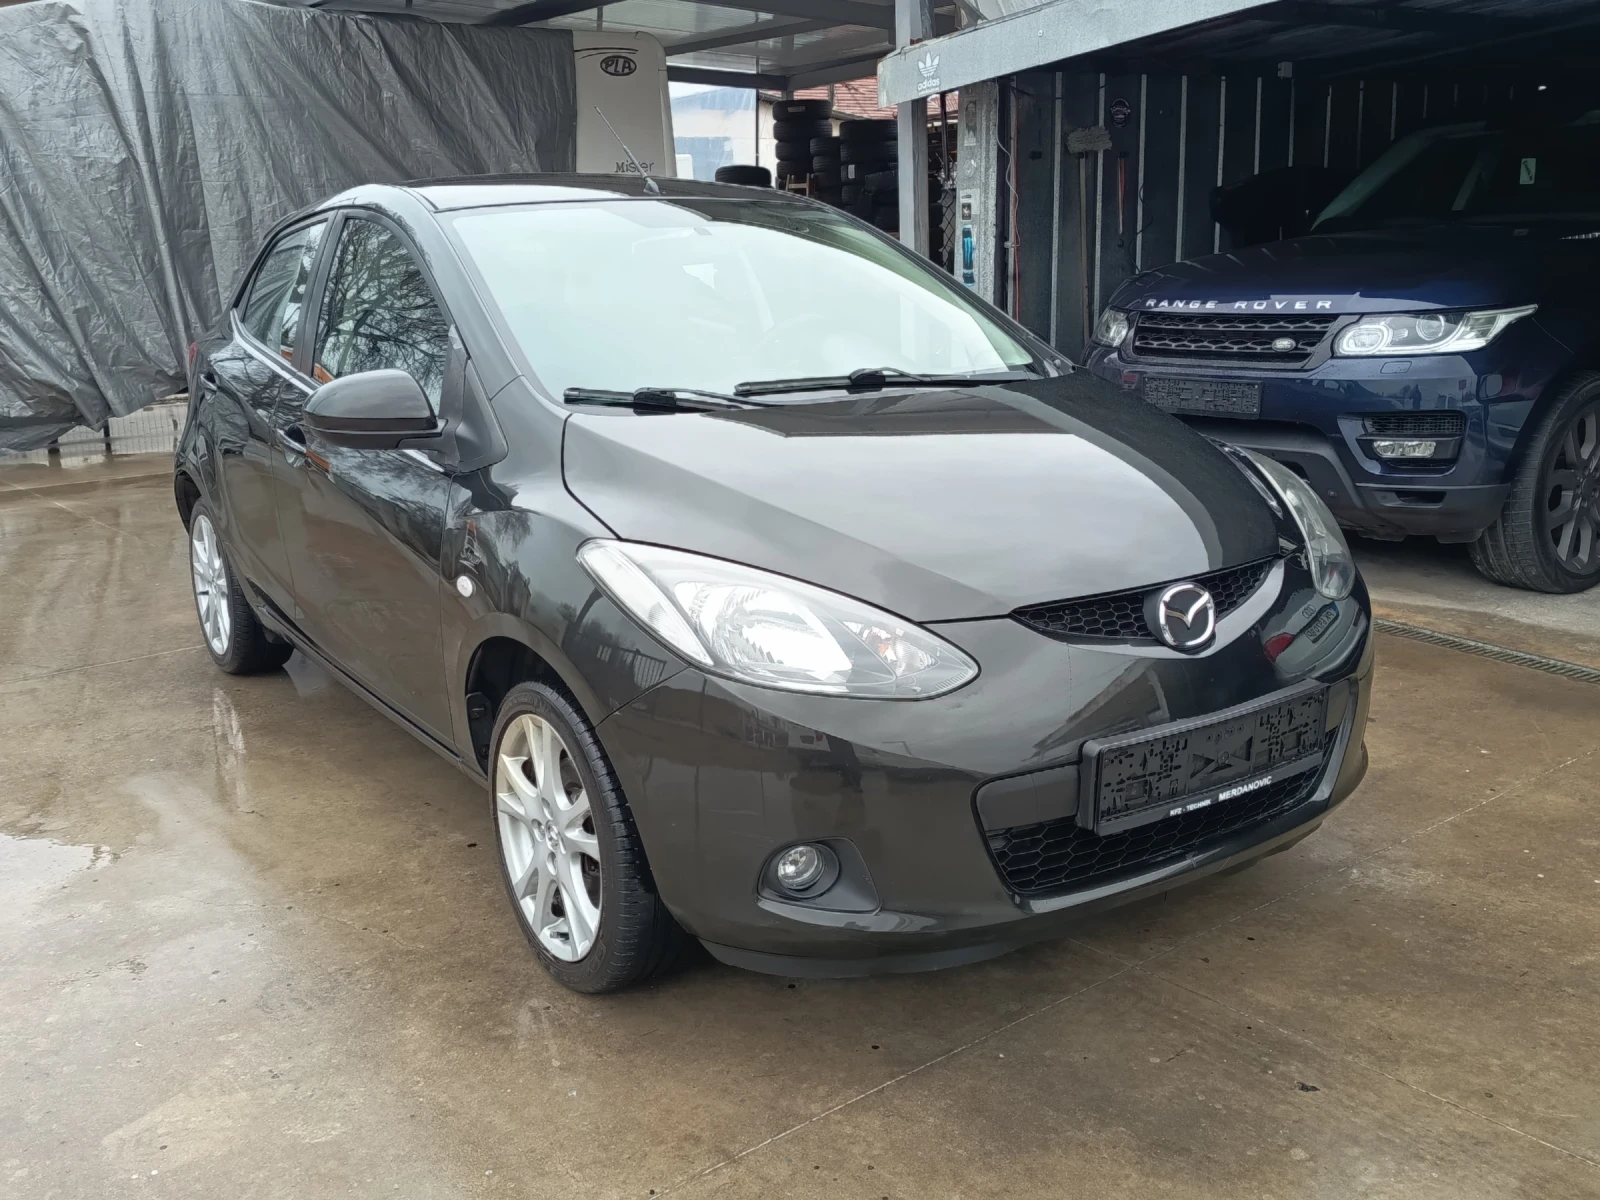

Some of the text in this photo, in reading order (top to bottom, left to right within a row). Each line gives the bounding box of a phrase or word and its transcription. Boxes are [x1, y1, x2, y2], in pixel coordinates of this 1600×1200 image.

[603, 58, 633, 73] PLA
[614, 160, 655, 173] Miser
[1145, 298, 1332, 310] RANGE ROVER
[1169, 807, 1183, 816] KFZ
[1186, 799, 1212, 812] TECHNIK
[1218, 776, 1272, 802] MERDANOVIC
